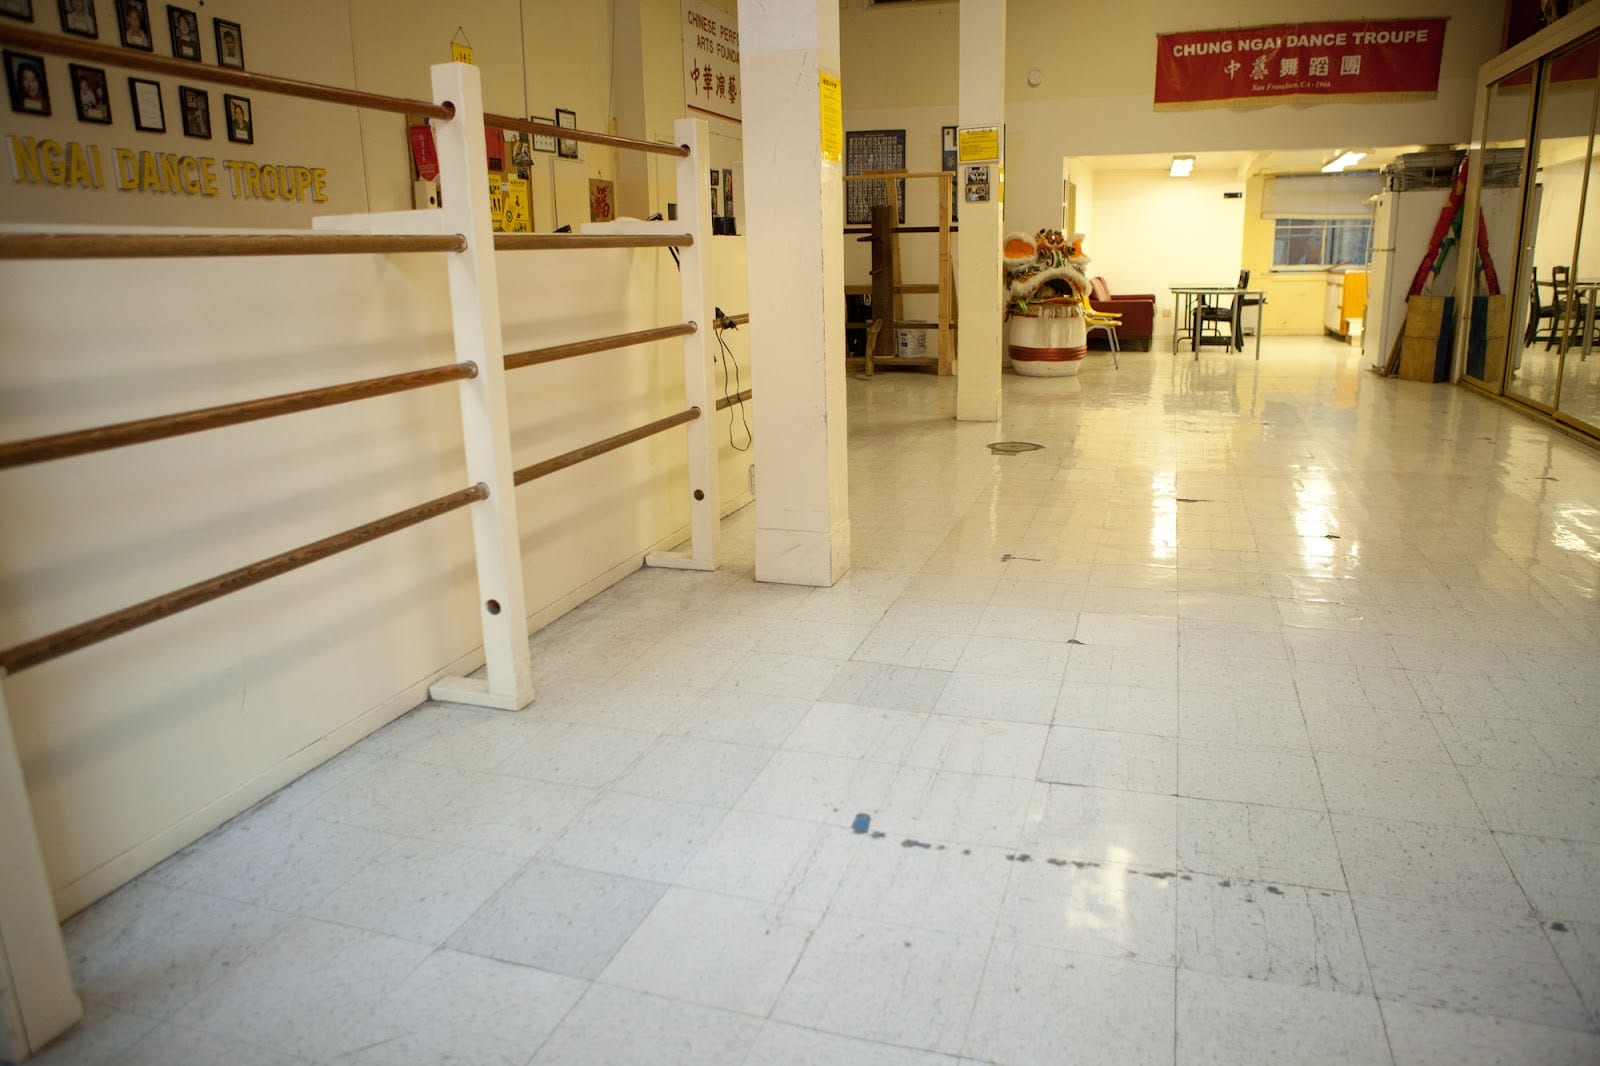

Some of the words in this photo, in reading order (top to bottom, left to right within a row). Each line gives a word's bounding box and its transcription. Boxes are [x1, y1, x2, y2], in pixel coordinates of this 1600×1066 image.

[688, 10, 716, 36] CHINESE
[697, 34, 713, 53] ARTS
[1173, 40, 1233, 57] CHUNG
[1238, 37, 1281, 51] NGAI
[1287, 33, 1347, 47] DANCE
[1352, 29, 1428, 44] TROUPE
[690, 57, 741, 104] 中華演藝
[6, 135, 104, 188] NGAI
[112, 148, 219, 196] DANCE
[224, 160, 328, 202] TROUPE
